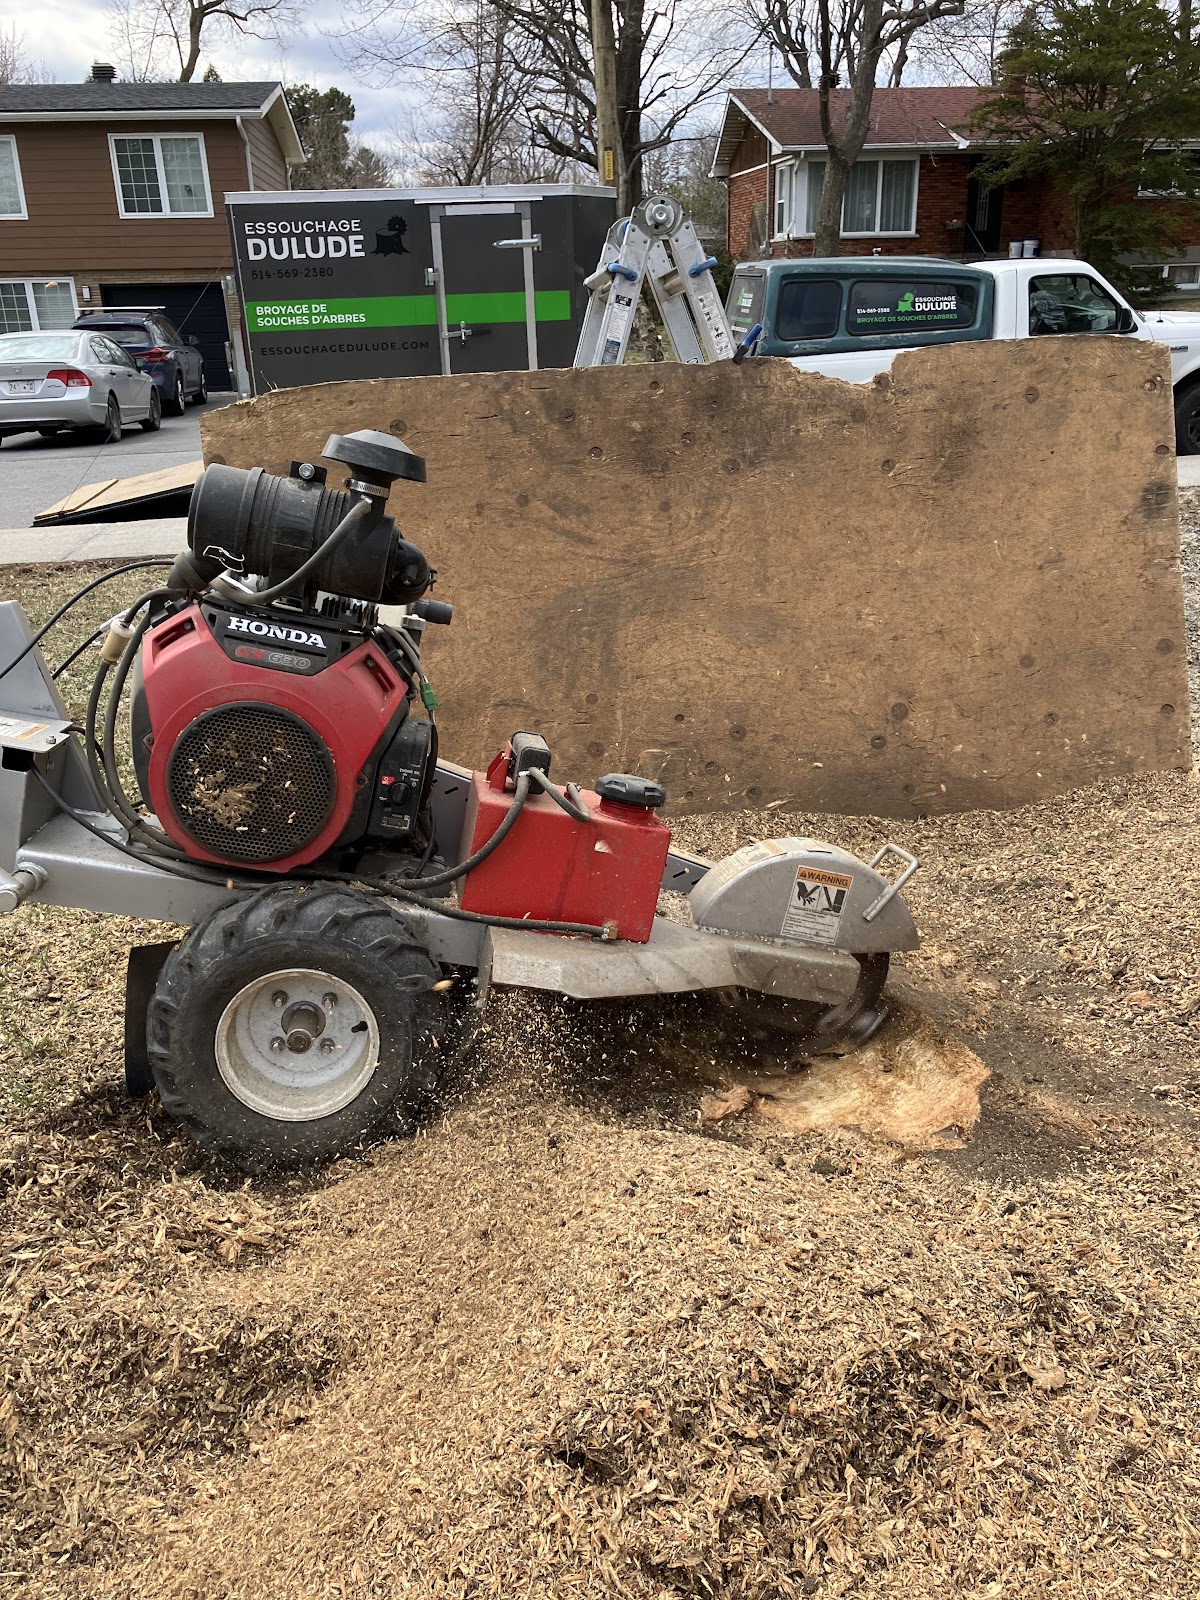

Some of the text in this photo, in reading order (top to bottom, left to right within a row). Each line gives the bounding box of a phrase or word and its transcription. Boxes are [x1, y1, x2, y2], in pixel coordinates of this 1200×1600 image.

[244, 220, 361, 234] ESSOUCHAGE
[247, 235, 365, 260] DULUDE
[251, 268, 334, 280] 514-569-2380
[256, 304, 327, 316] BROYAGE DE
[915, 302, 957, 311] DULUDE
[257, 313, 366, 327] SOUCHES D'ARBRES
[261, 341, 430, 356] ESSOUCHAGEDULUDE.COM
[227, 616, 327, 649] HONDA
[235, 645, 268, 661] GX
[807, 872, 848, 887] WARNING
